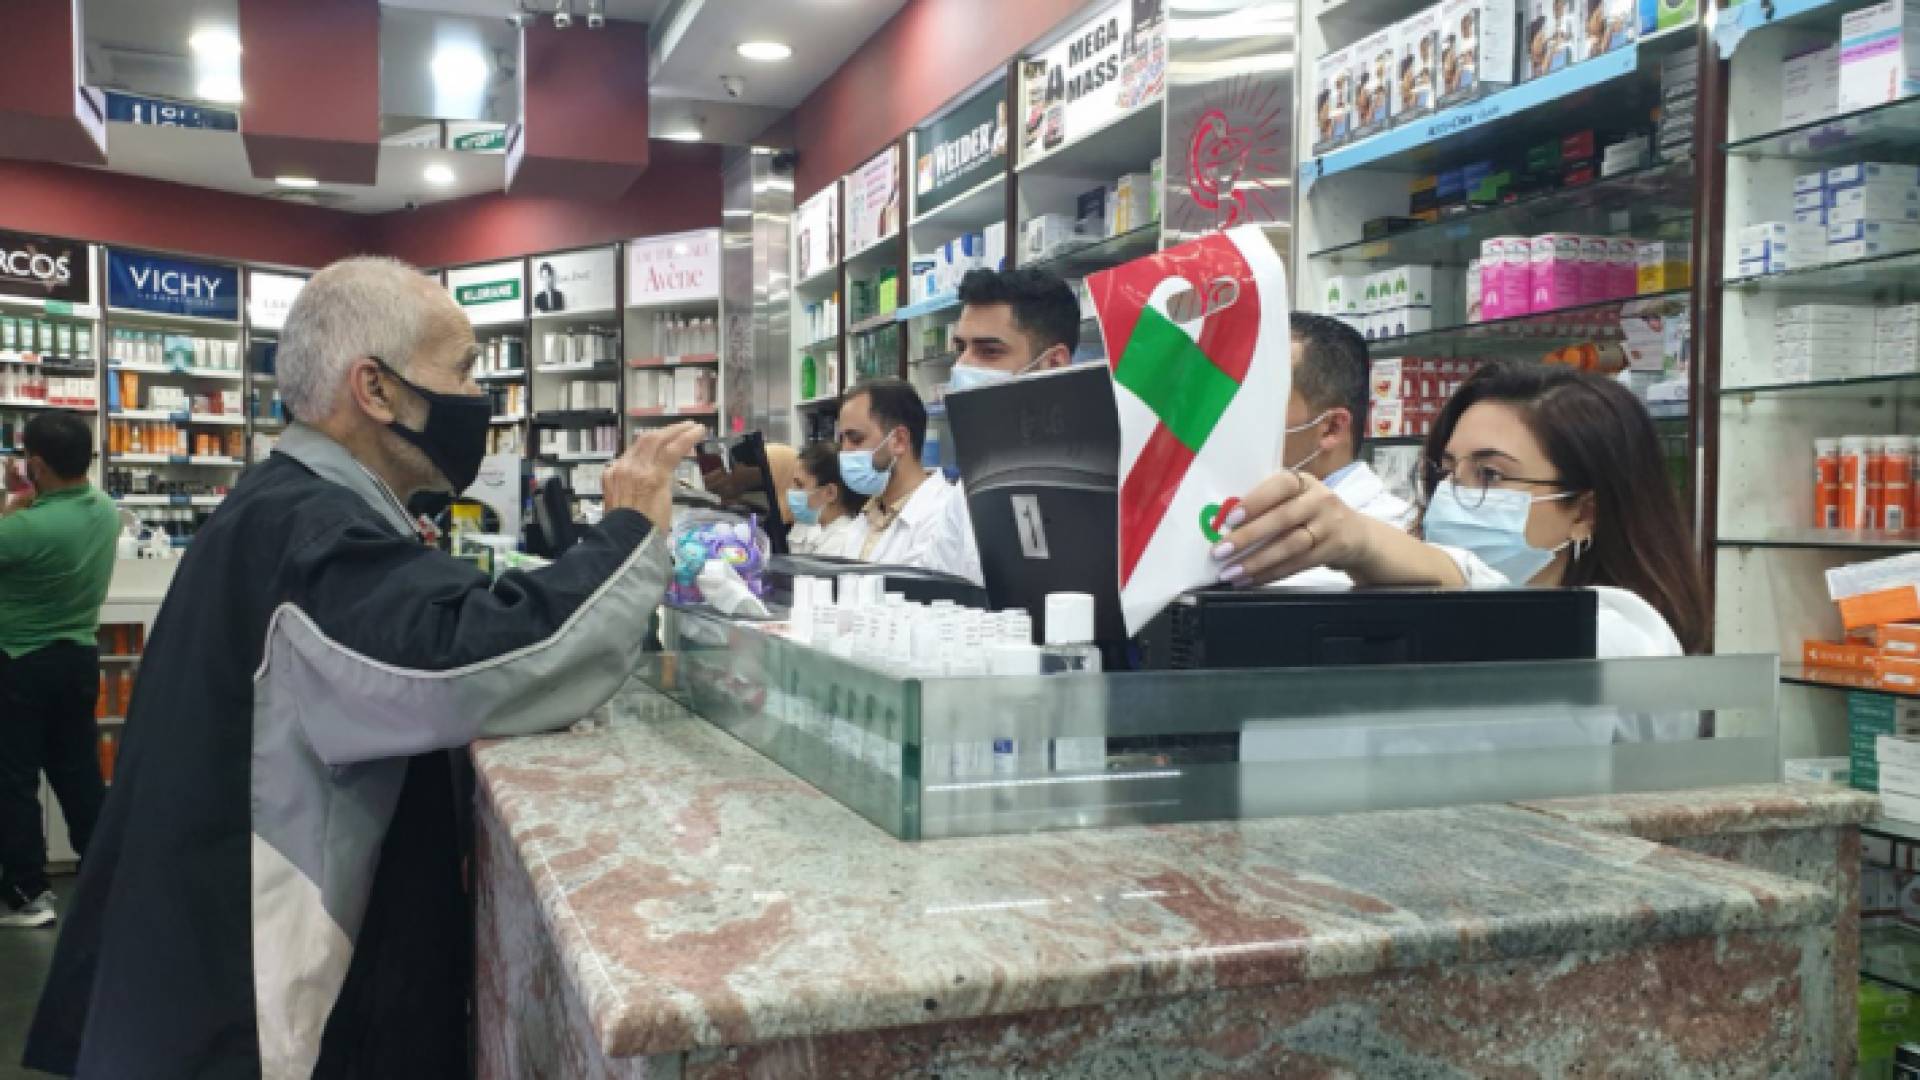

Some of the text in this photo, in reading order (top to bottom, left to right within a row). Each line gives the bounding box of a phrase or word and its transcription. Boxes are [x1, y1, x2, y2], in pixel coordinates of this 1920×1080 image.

[1068, 17, 1119, 68] MEGA
[1066, 53, 1119, 104] MASS
[933, 122, 991, 178] WEIDER
[129, 265, 223, 301] VICHY
